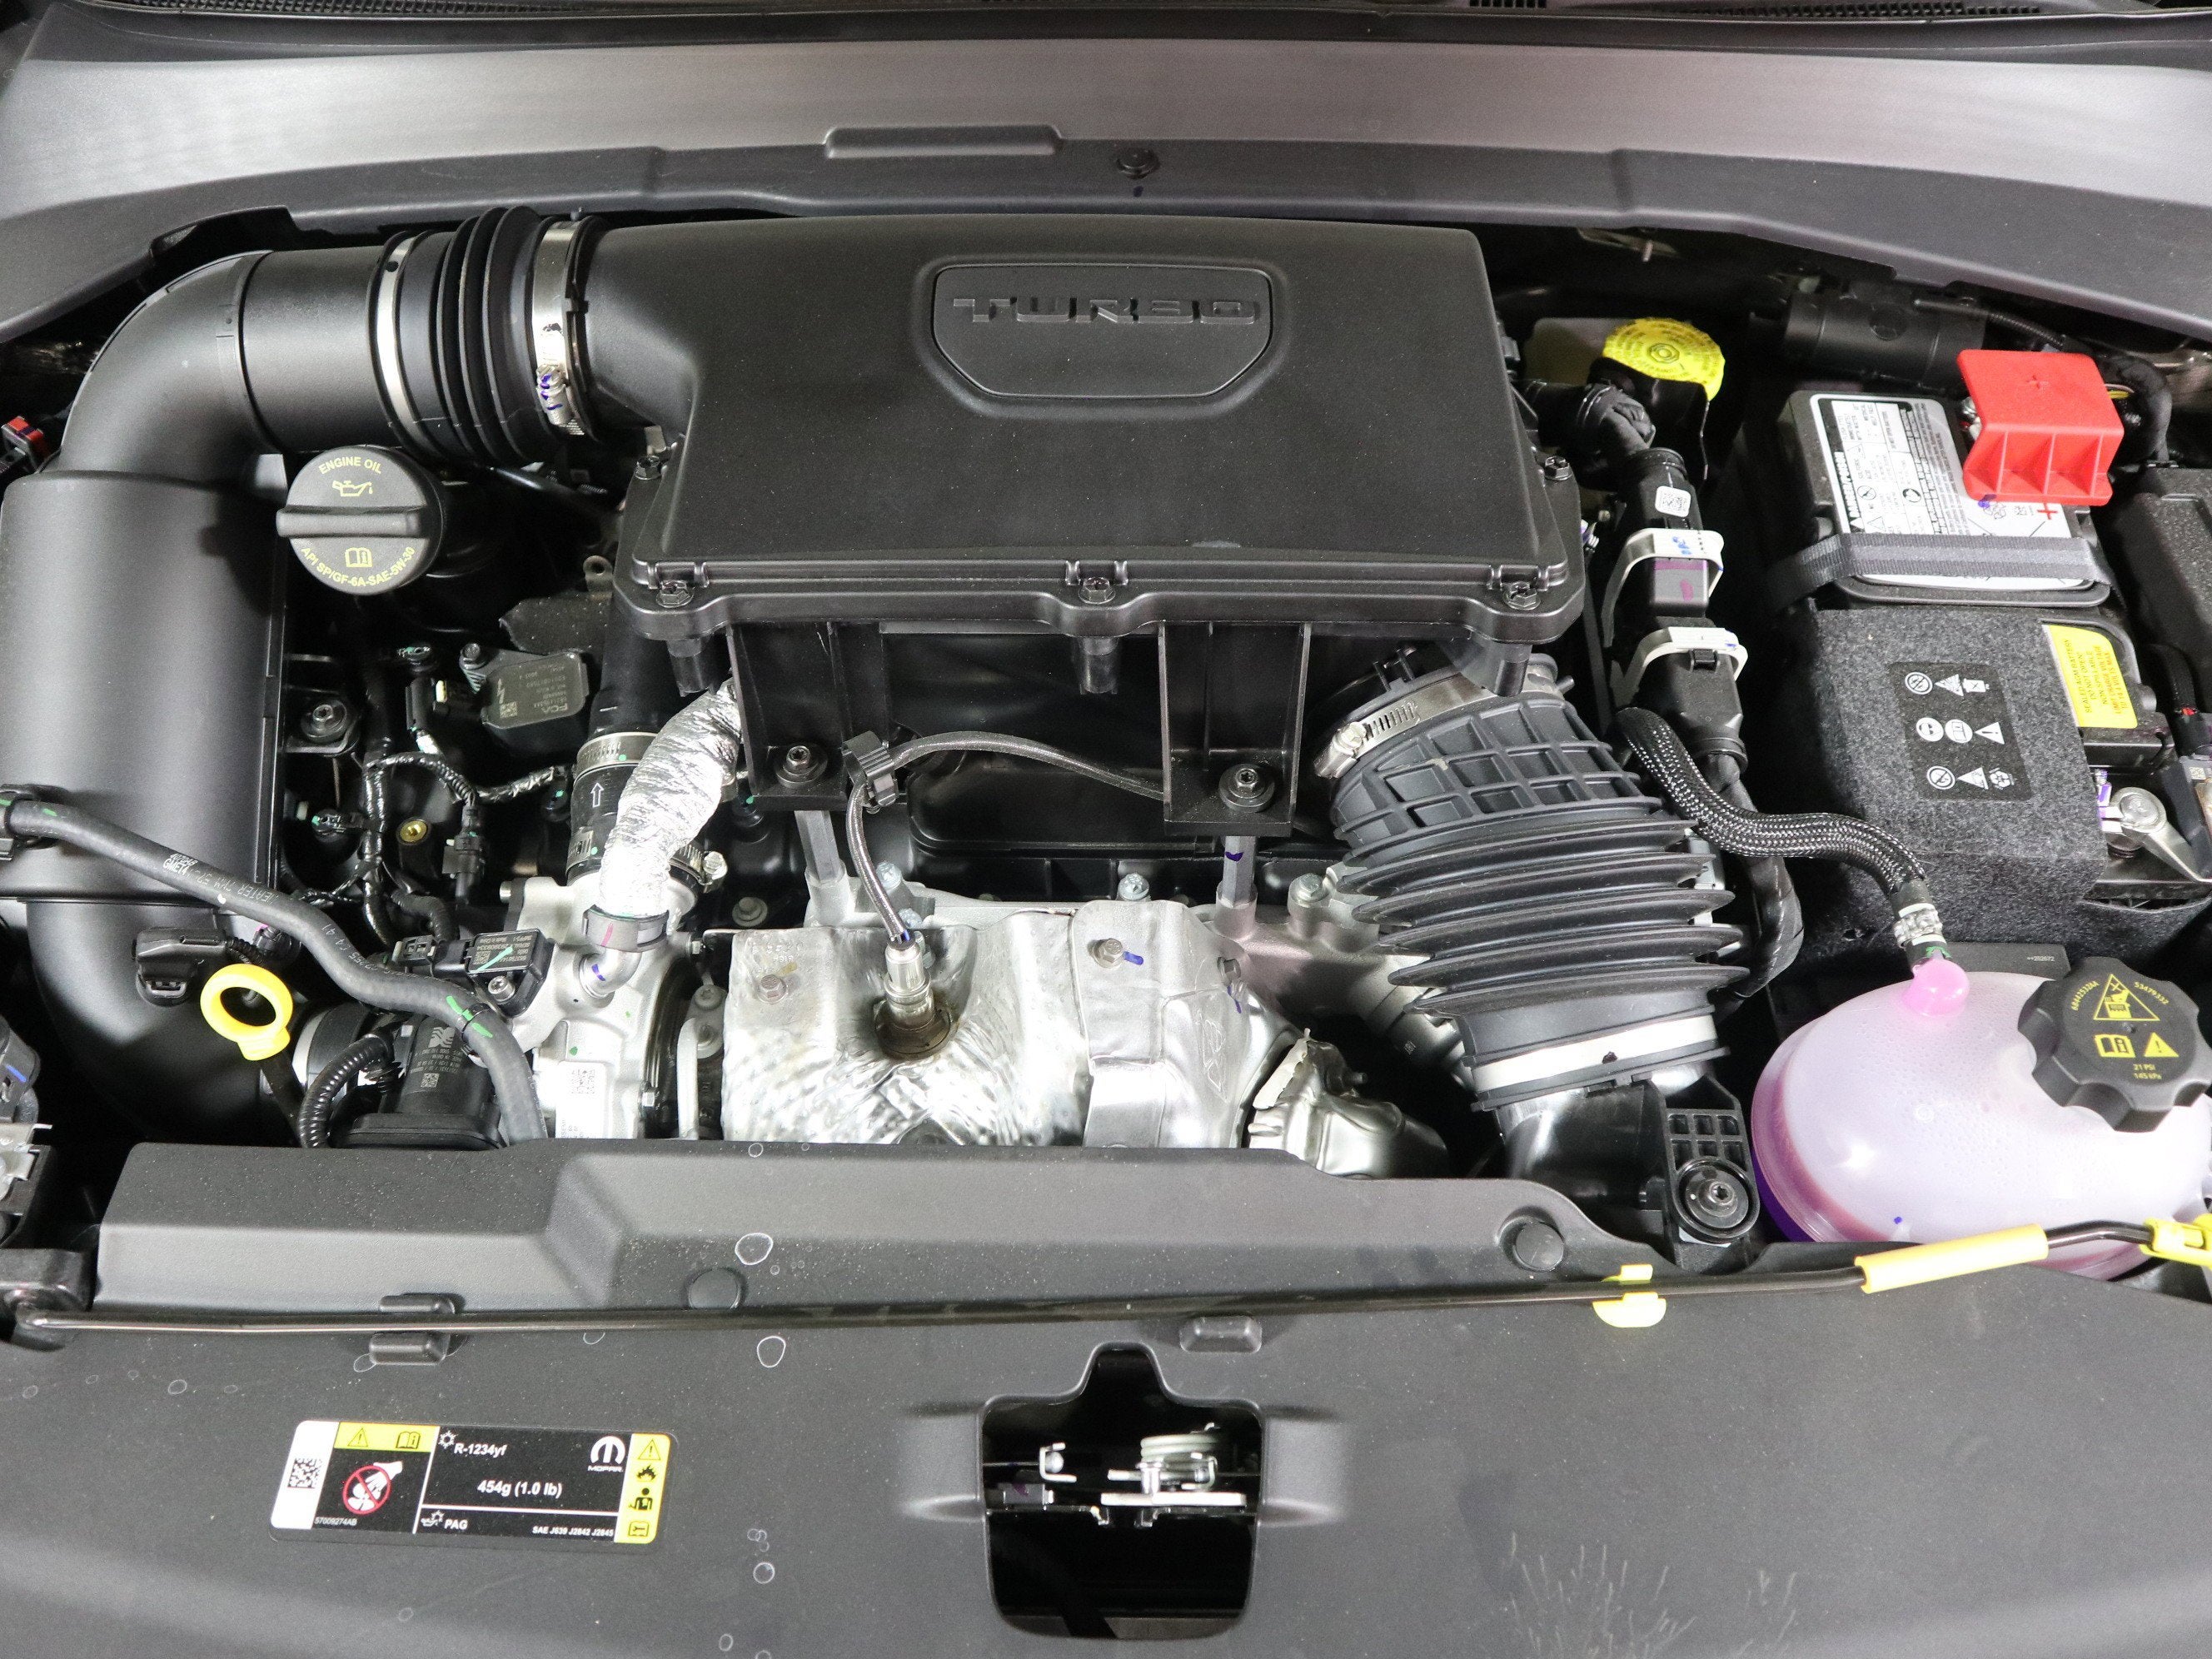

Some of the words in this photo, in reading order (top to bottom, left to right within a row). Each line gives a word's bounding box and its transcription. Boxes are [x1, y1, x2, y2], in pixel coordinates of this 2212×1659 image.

[954, 296, 1260, 324] TURBO
[318, 456, 361, 475] ENGINE
[364, 459, 382, 475] OIL
[301, 546, 320, 565] API
[2065, 638, 2077, 669] BATTERY
[454, 1441, 508, 1457] R-1234yf
[587, 1465, 622, 1473] MOPAR
[477, 1480, 511, 1498] 454g
[514, 1482, 541, 1498] (1.0
[543, 1482, 563, 1498] lb)
[444, 1518, 468, 1531] PAG
[532, 1526, 549, 1534] SAE
[550, 1527, 568, 1535] J639
